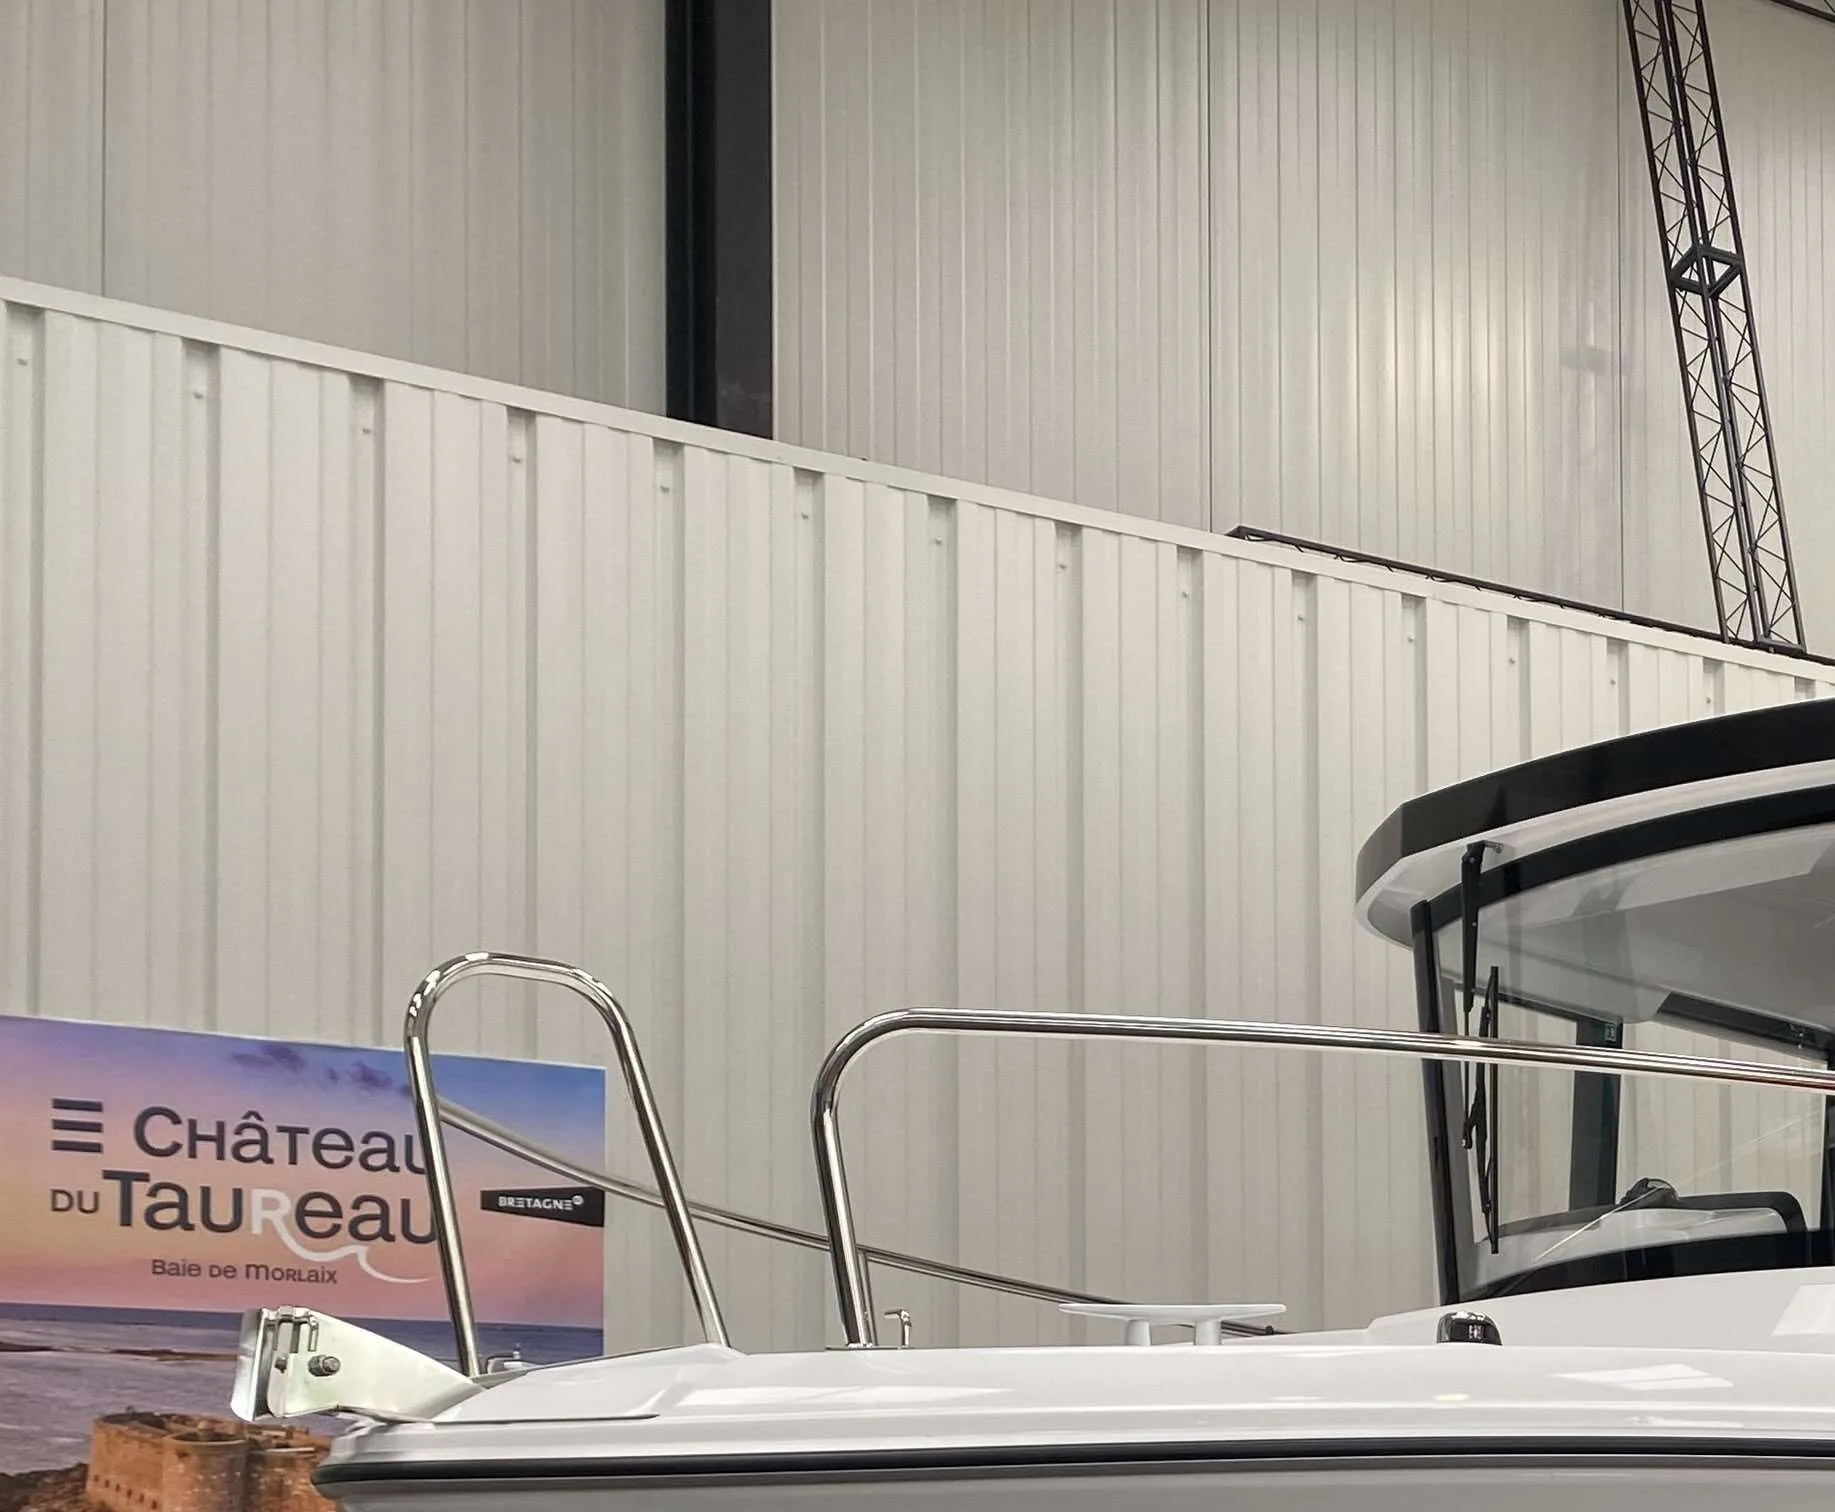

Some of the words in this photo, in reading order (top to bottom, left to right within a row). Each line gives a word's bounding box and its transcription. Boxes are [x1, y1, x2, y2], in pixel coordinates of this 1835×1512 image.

[51, 1189, 99, 1214] DU
[498, 1195, 573, 1211] BRETAGNE
[151, 1259, 201, 1277] Baie
